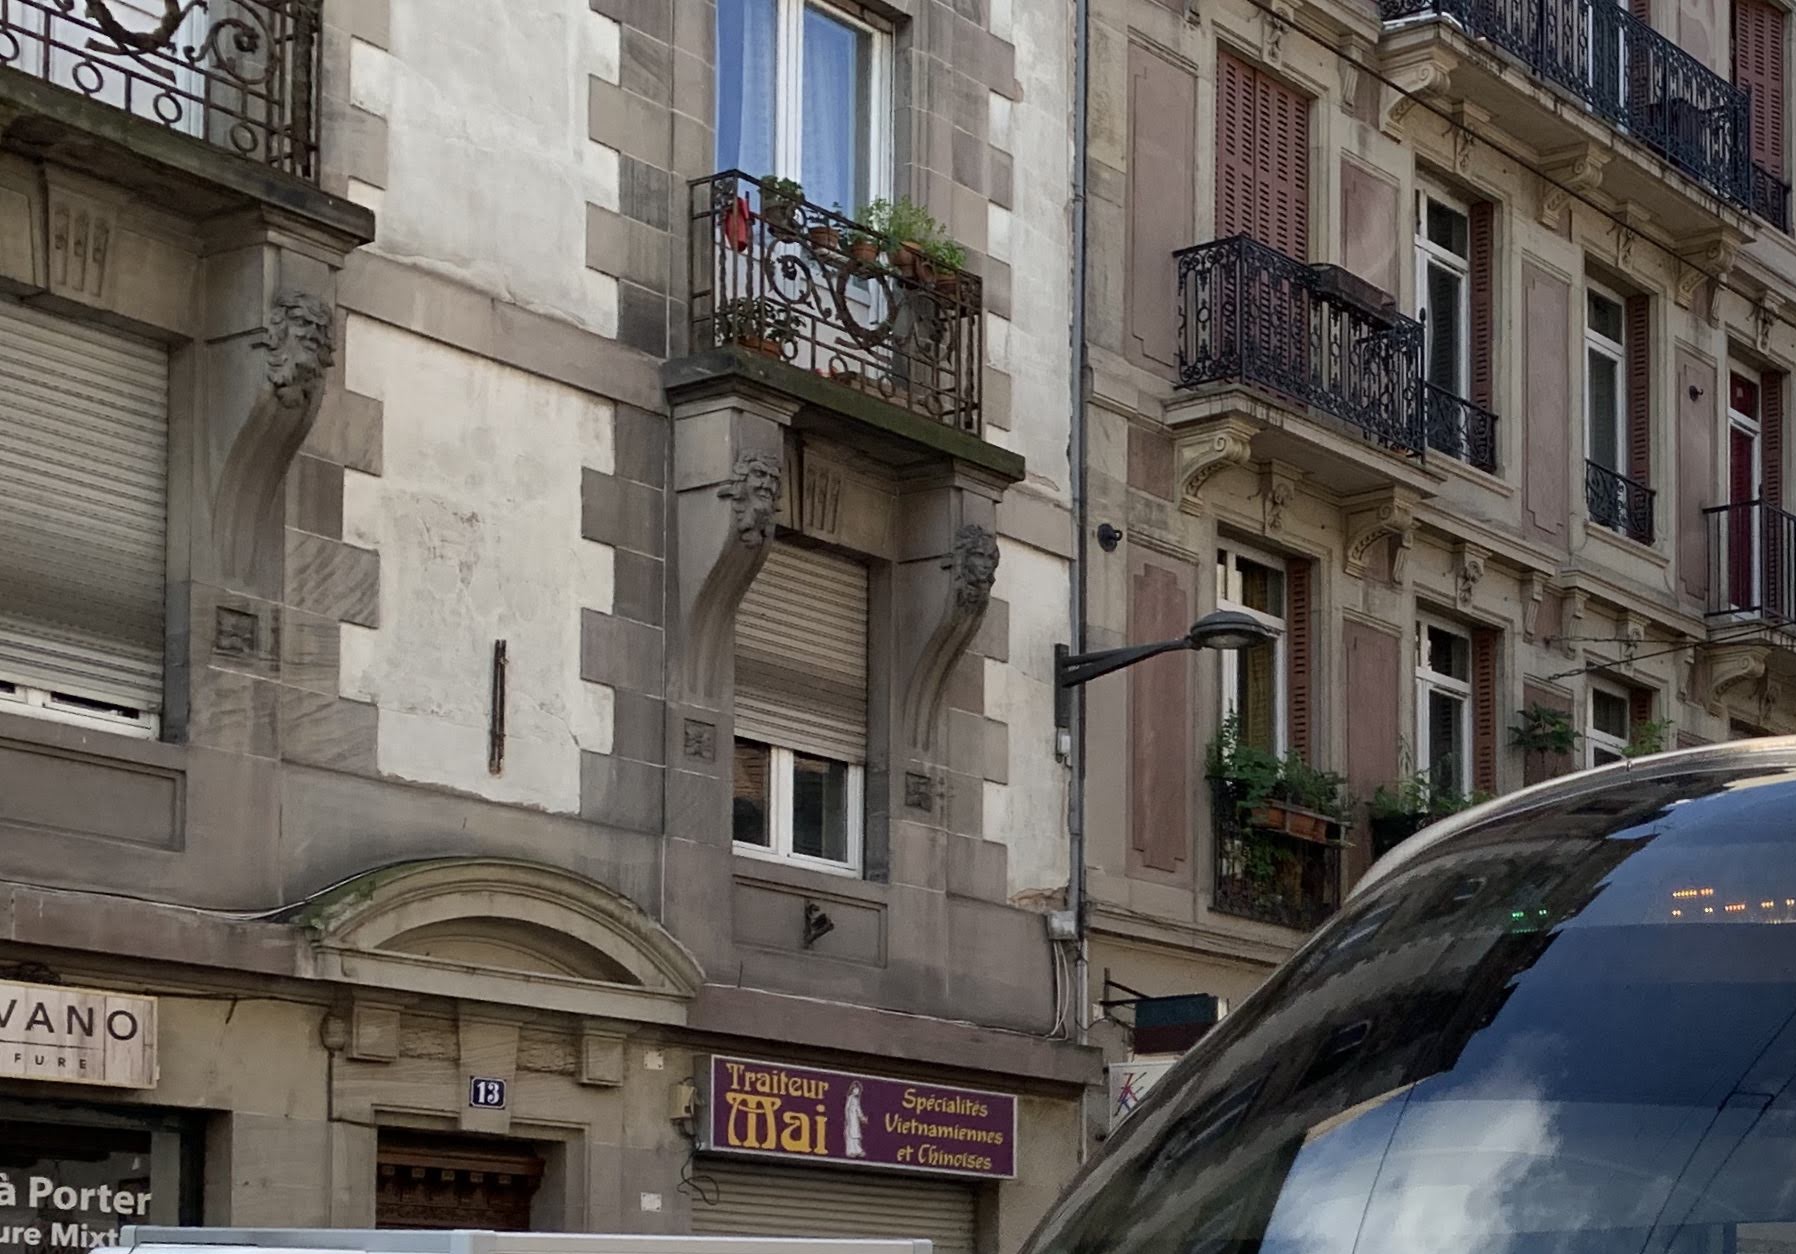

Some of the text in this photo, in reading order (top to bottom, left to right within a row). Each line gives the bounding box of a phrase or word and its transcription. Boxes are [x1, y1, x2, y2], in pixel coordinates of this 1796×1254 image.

[14, 1053, 87, 1070] FURE
[477, 1080, 500, 1105] 13
[726, 1062, 829, 1100] Traiteur
[902, 1088, 989, 1118] Spécialités
[725, 1091, 829, 1155] Mai
[885, 1113, 1004, 1145] Vietnamiennes
[896, 1144, 992, 1171] et Chinoises
[28, 1175, 153, 1216] Porter
